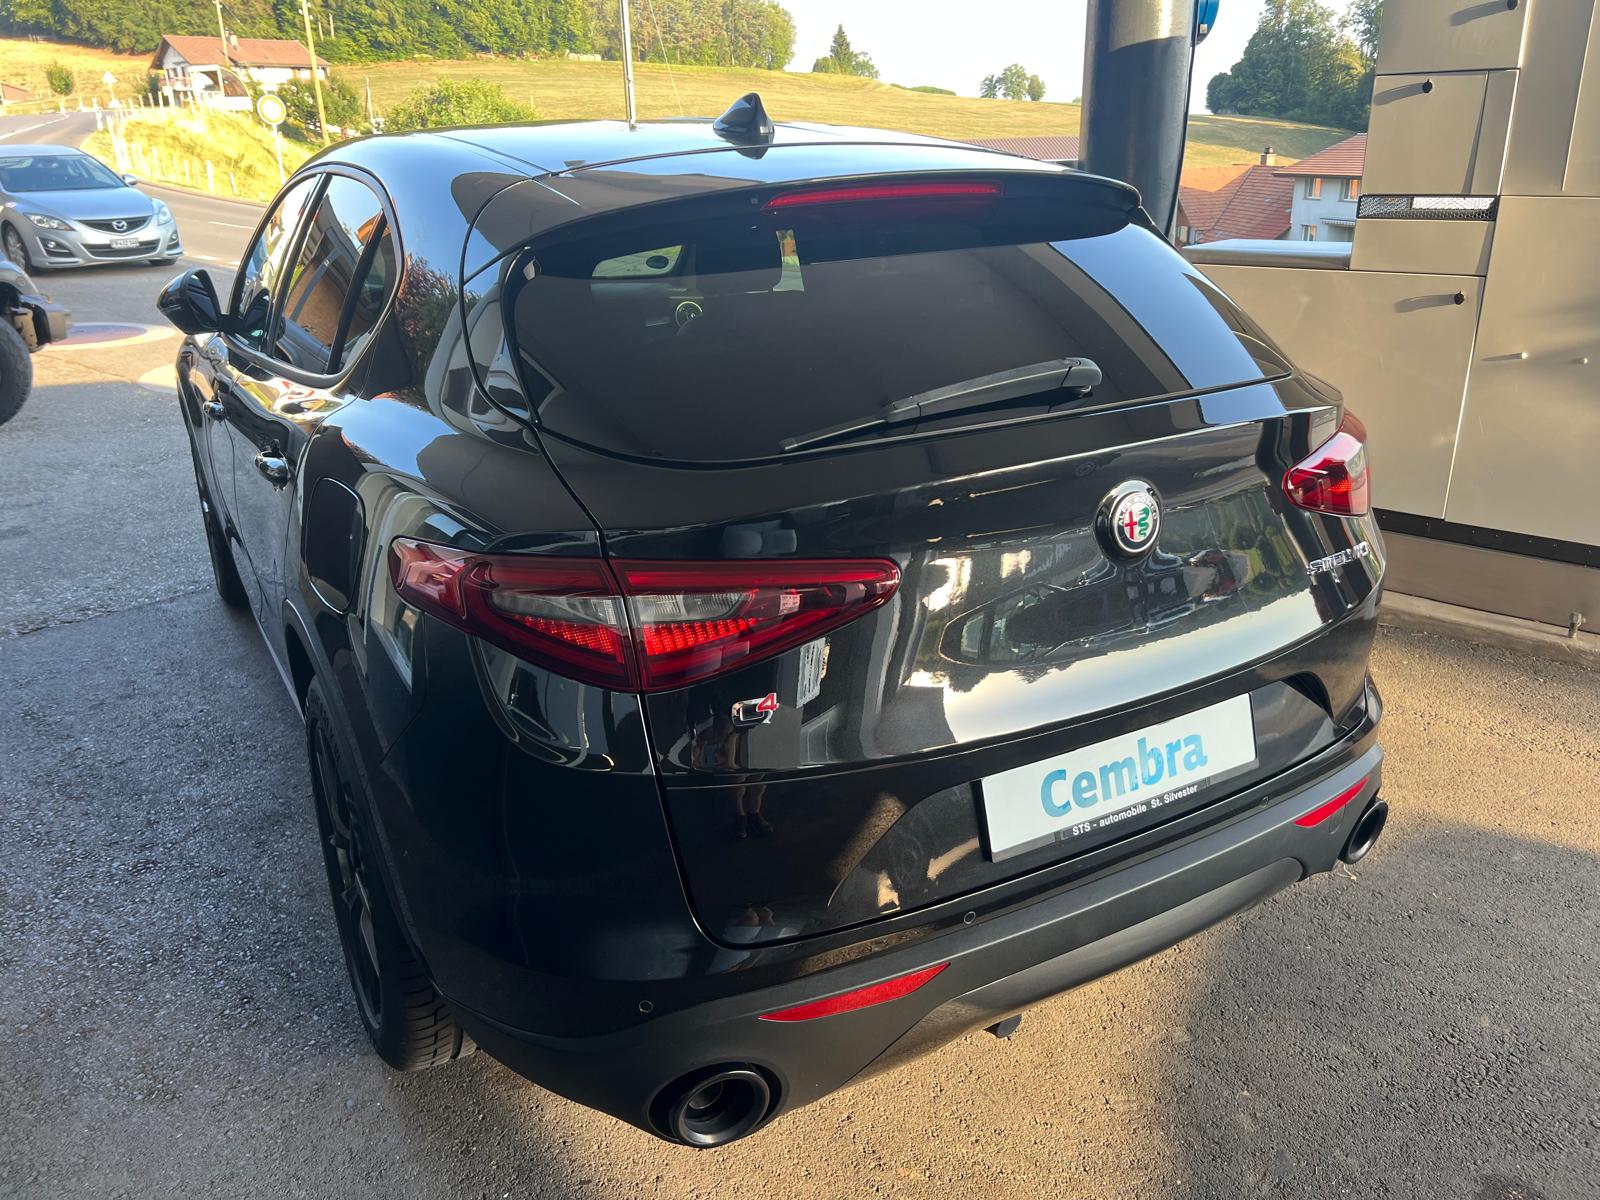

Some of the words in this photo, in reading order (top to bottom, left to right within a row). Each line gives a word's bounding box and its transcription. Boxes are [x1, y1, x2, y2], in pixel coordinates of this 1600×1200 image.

[1040, 734, 1209, 818] Cembra
[1072, 822, 1091, 836] STS
[1099, 803, 1147, 827] automobile
[1150, 798, 1163, 809] St.
[1163, 785, 1198, 804] Silvester
